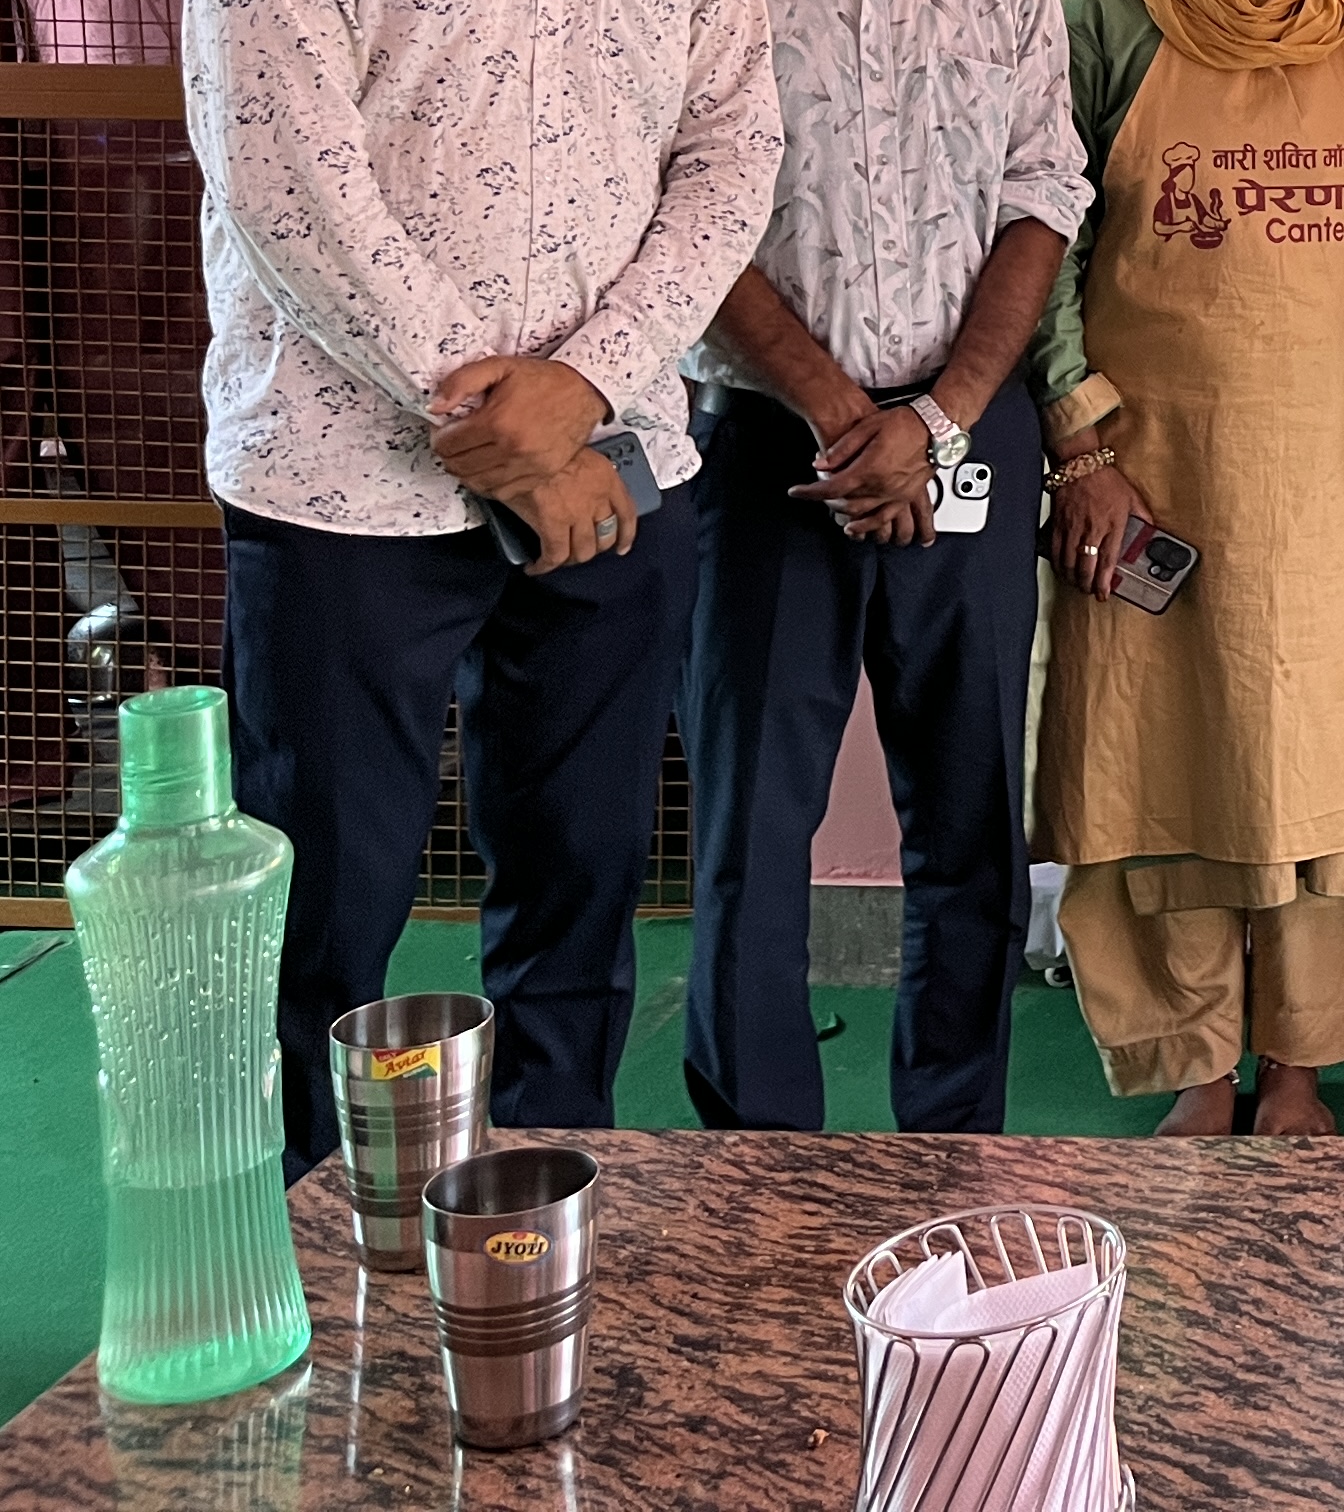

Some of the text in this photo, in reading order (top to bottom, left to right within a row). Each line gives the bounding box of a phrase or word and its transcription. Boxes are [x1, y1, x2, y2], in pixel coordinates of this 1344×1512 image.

[1212, 143, 1257, 170] नारी
[1263, 141, 1318, 171] शक्ति
[490, 1238, 546, 1256] JYOTI
